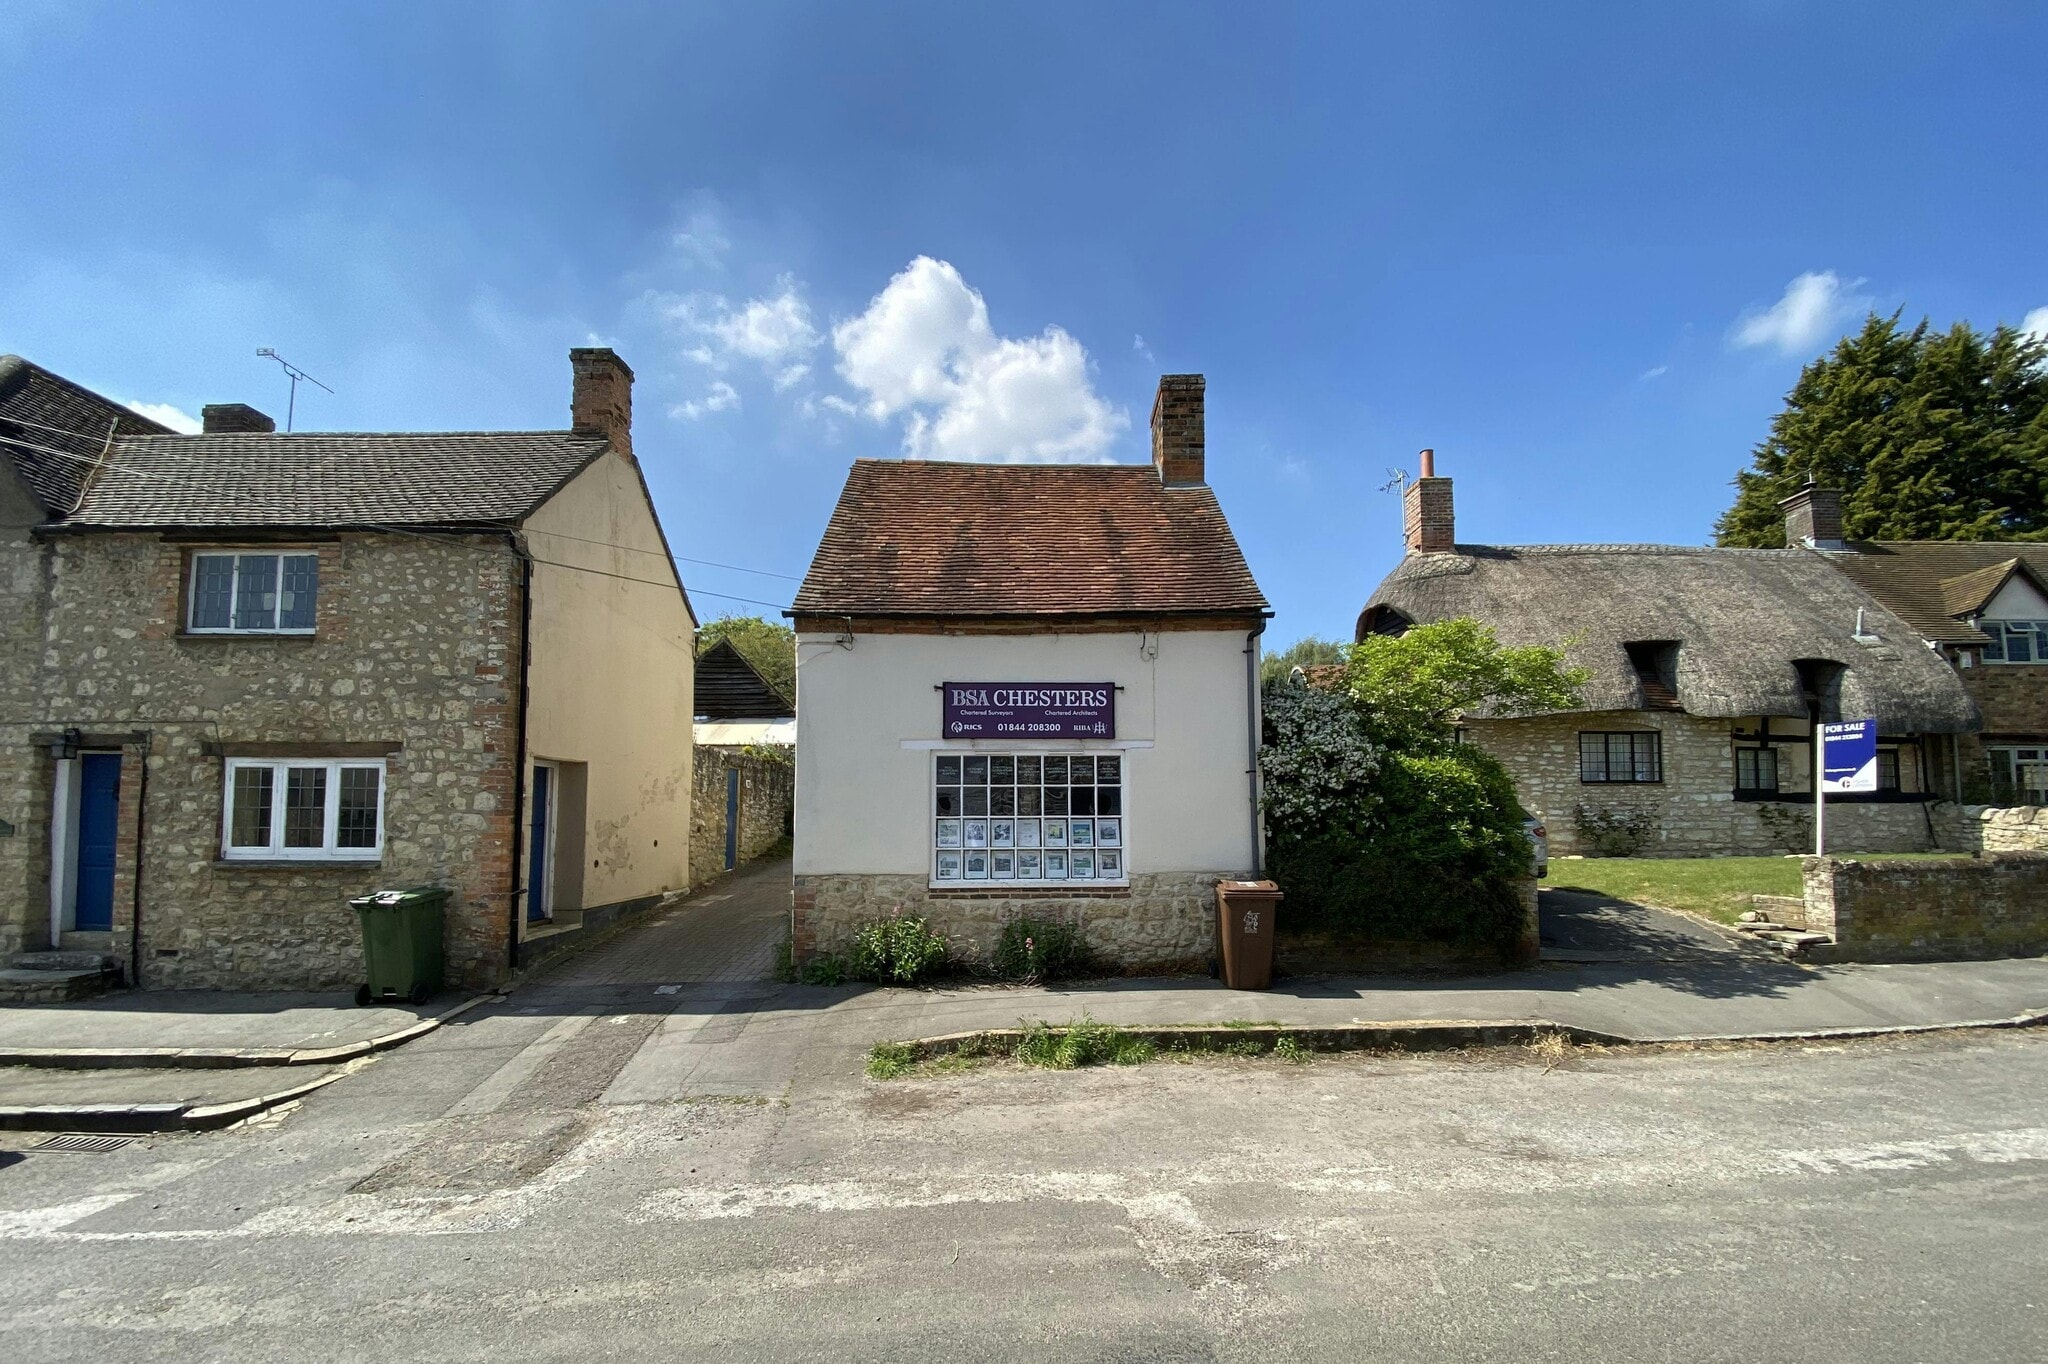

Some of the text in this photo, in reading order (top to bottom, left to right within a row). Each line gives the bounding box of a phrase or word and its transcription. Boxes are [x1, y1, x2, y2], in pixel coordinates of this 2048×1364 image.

[951, 689, 1108, 707] BSA CHESTERS
[988, 709, 1014, 717] Surveyors
[997, 723, 1061, 731] 01844 208300
[1825, 722, 1865, 733] FOR SALE
